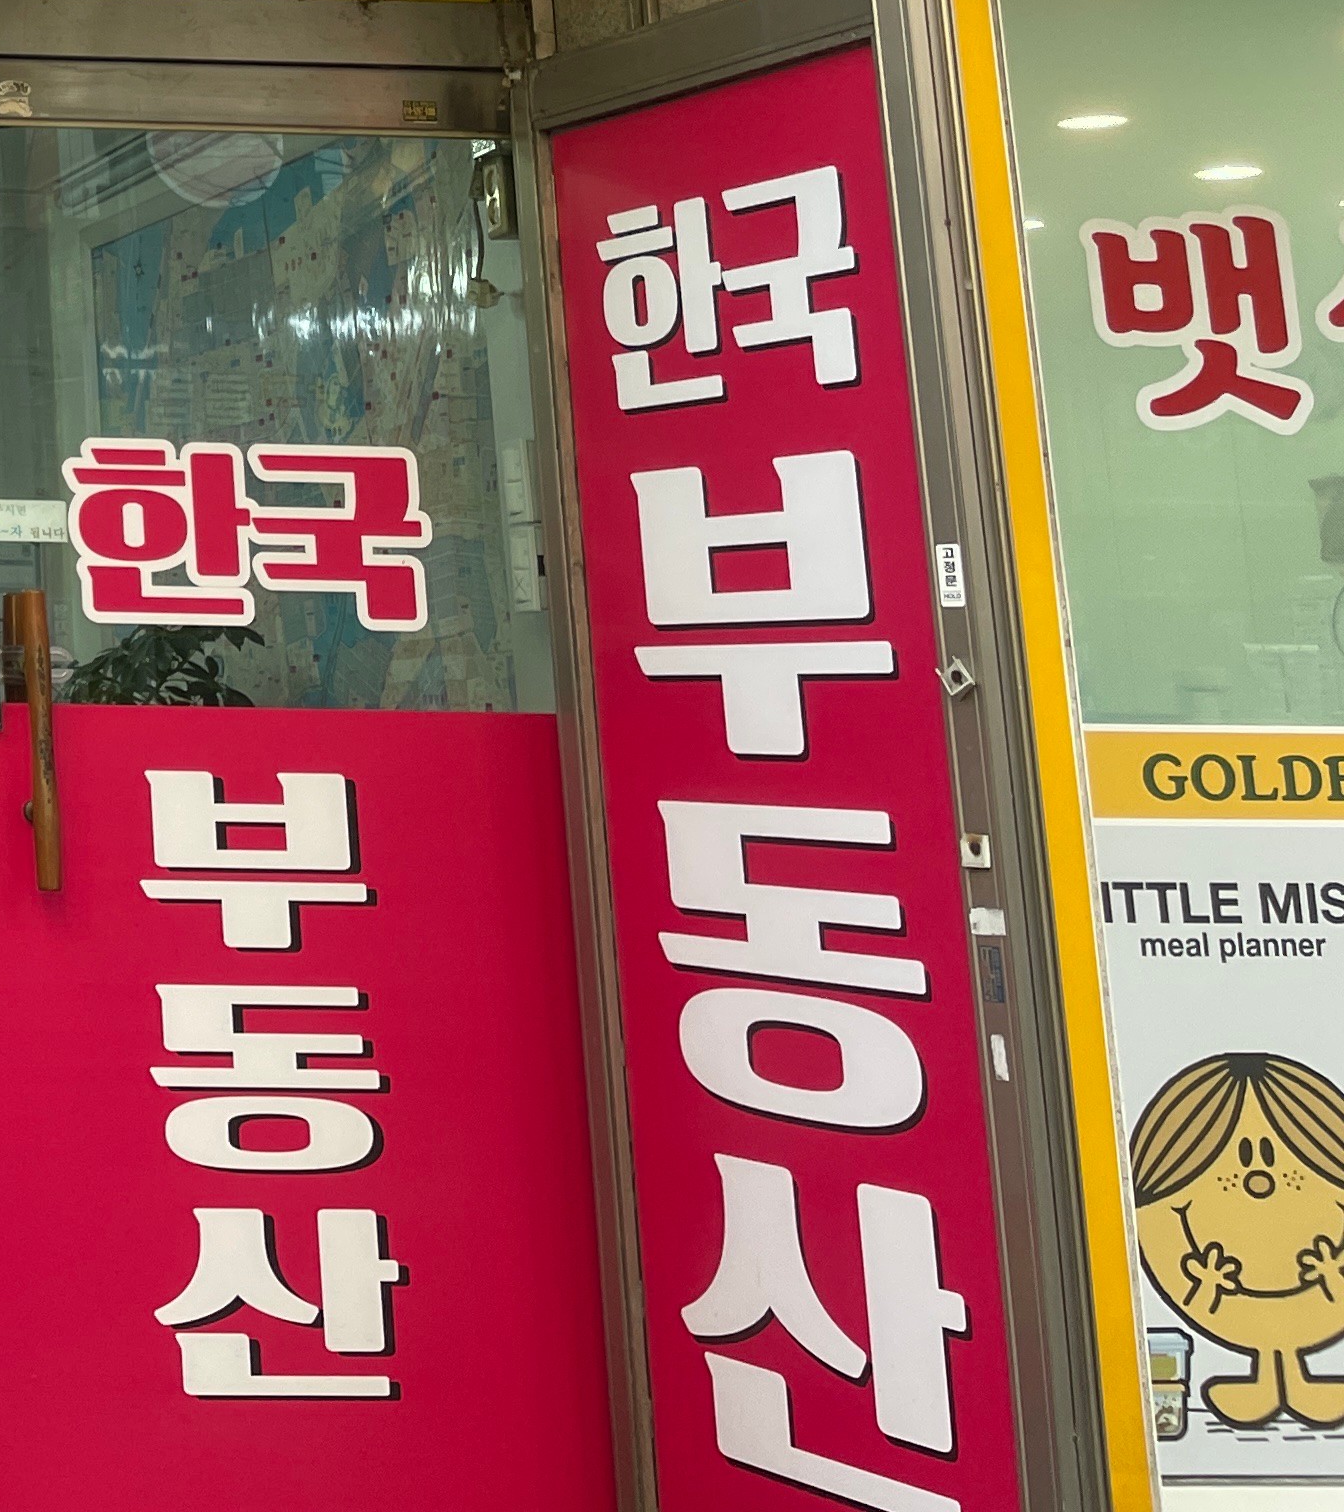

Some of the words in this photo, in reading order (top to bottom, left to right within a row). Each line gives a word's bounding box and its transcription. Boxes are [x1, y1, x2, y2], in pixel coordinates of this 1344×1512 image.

[597, 167, 854, 409] 한국
[1092, 214, 1344, 421] 뱃
[73, 447, 421, 623] 한국
[631, 450, 967, 1512] 부동산
[1140, 931, 1210, 957] meal
[1219, 932, 1326, 964] planner
[139, 769, 399, 1399] 부동산
